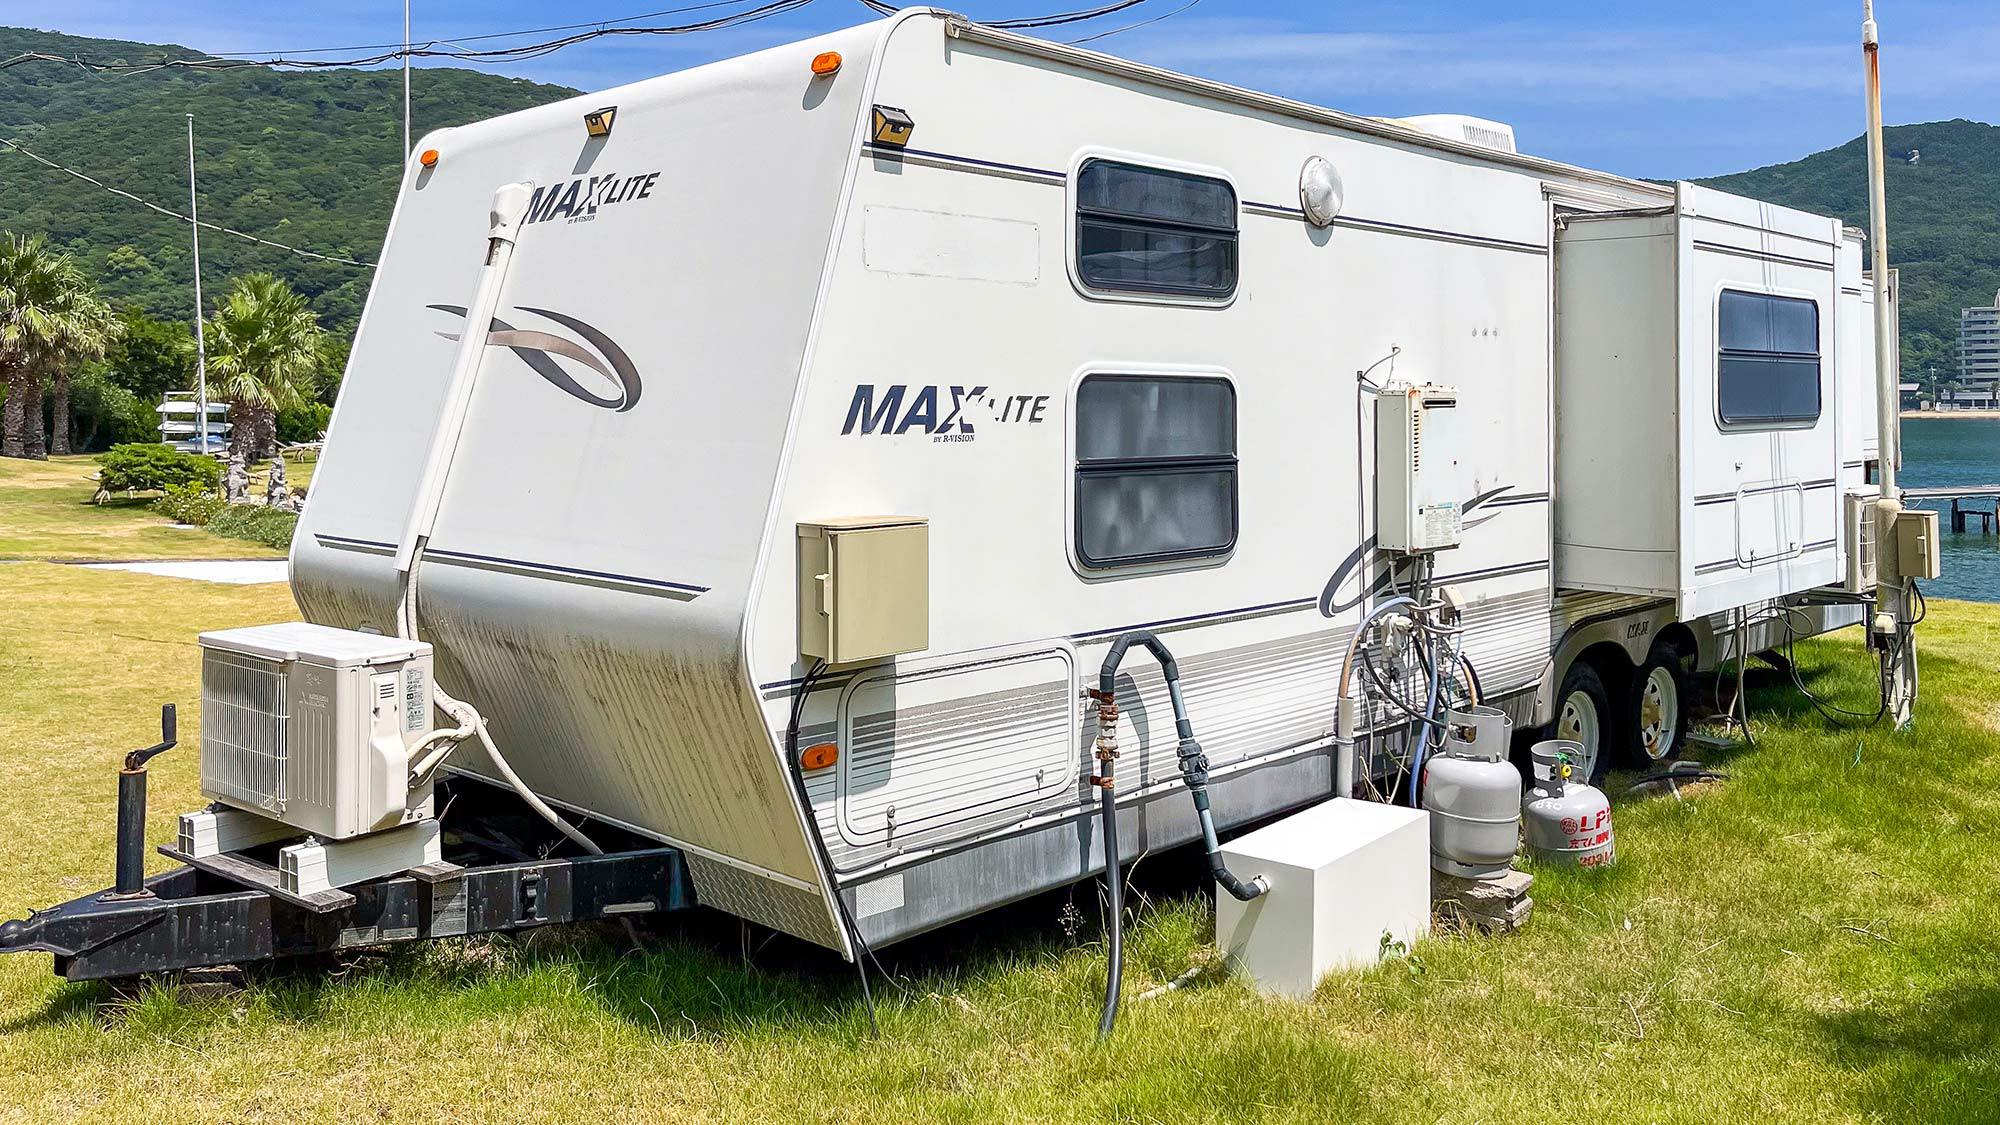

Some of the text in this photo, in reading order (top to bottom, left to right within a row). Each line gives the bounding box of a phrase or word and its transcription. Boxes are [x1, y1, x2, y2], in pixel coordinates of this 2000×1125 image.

[520, 171, 661, 225] MAX LITE
[840, 384, 988, 436] MAX
